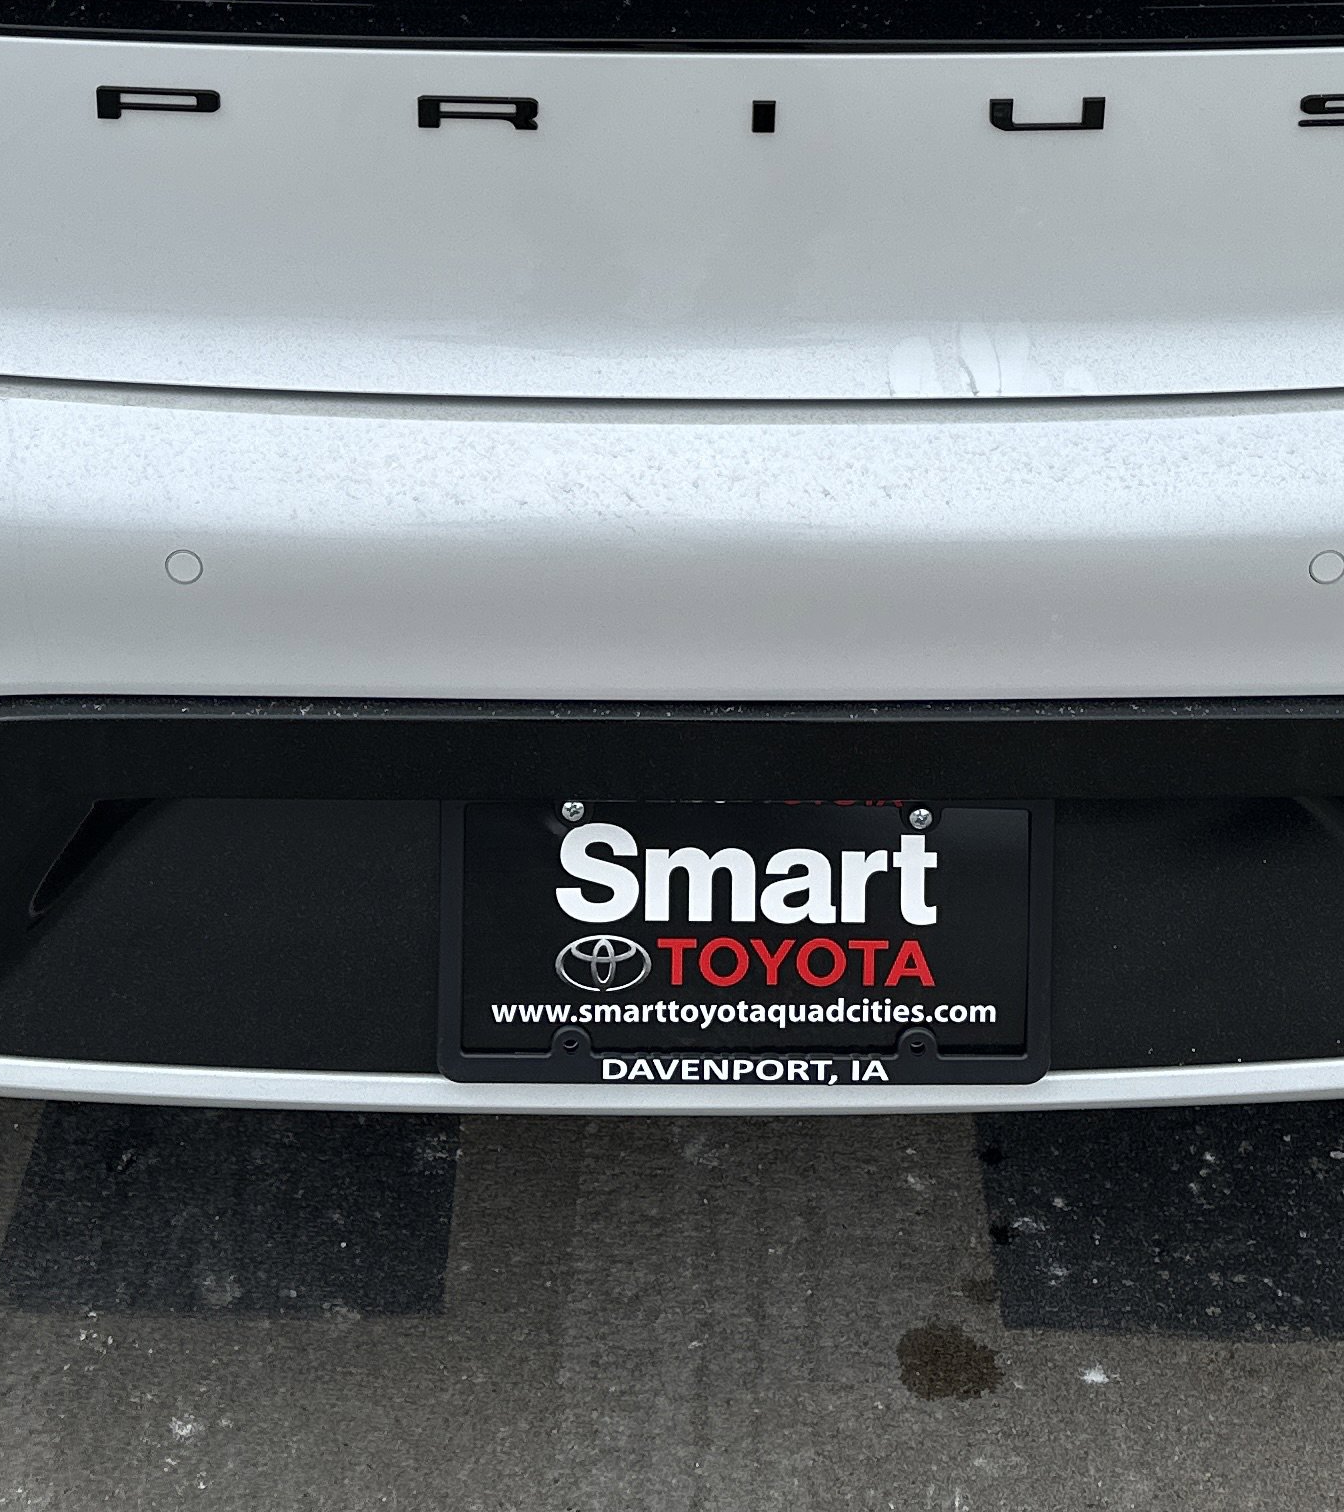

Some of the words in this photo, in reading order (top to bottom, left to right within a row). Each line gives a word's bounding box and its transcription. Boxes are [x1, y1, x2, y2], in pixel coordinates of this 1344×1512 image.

[555, 823, 938, 926] Smart
[656, 936, 936, 988] TOYOTA
[491, 998, 997, 1030] www.smarttoyotaquadcities.com
[601, 1058, 840, 1087] DAVENPORT,
[850, 1059, 890, 1082] IA
